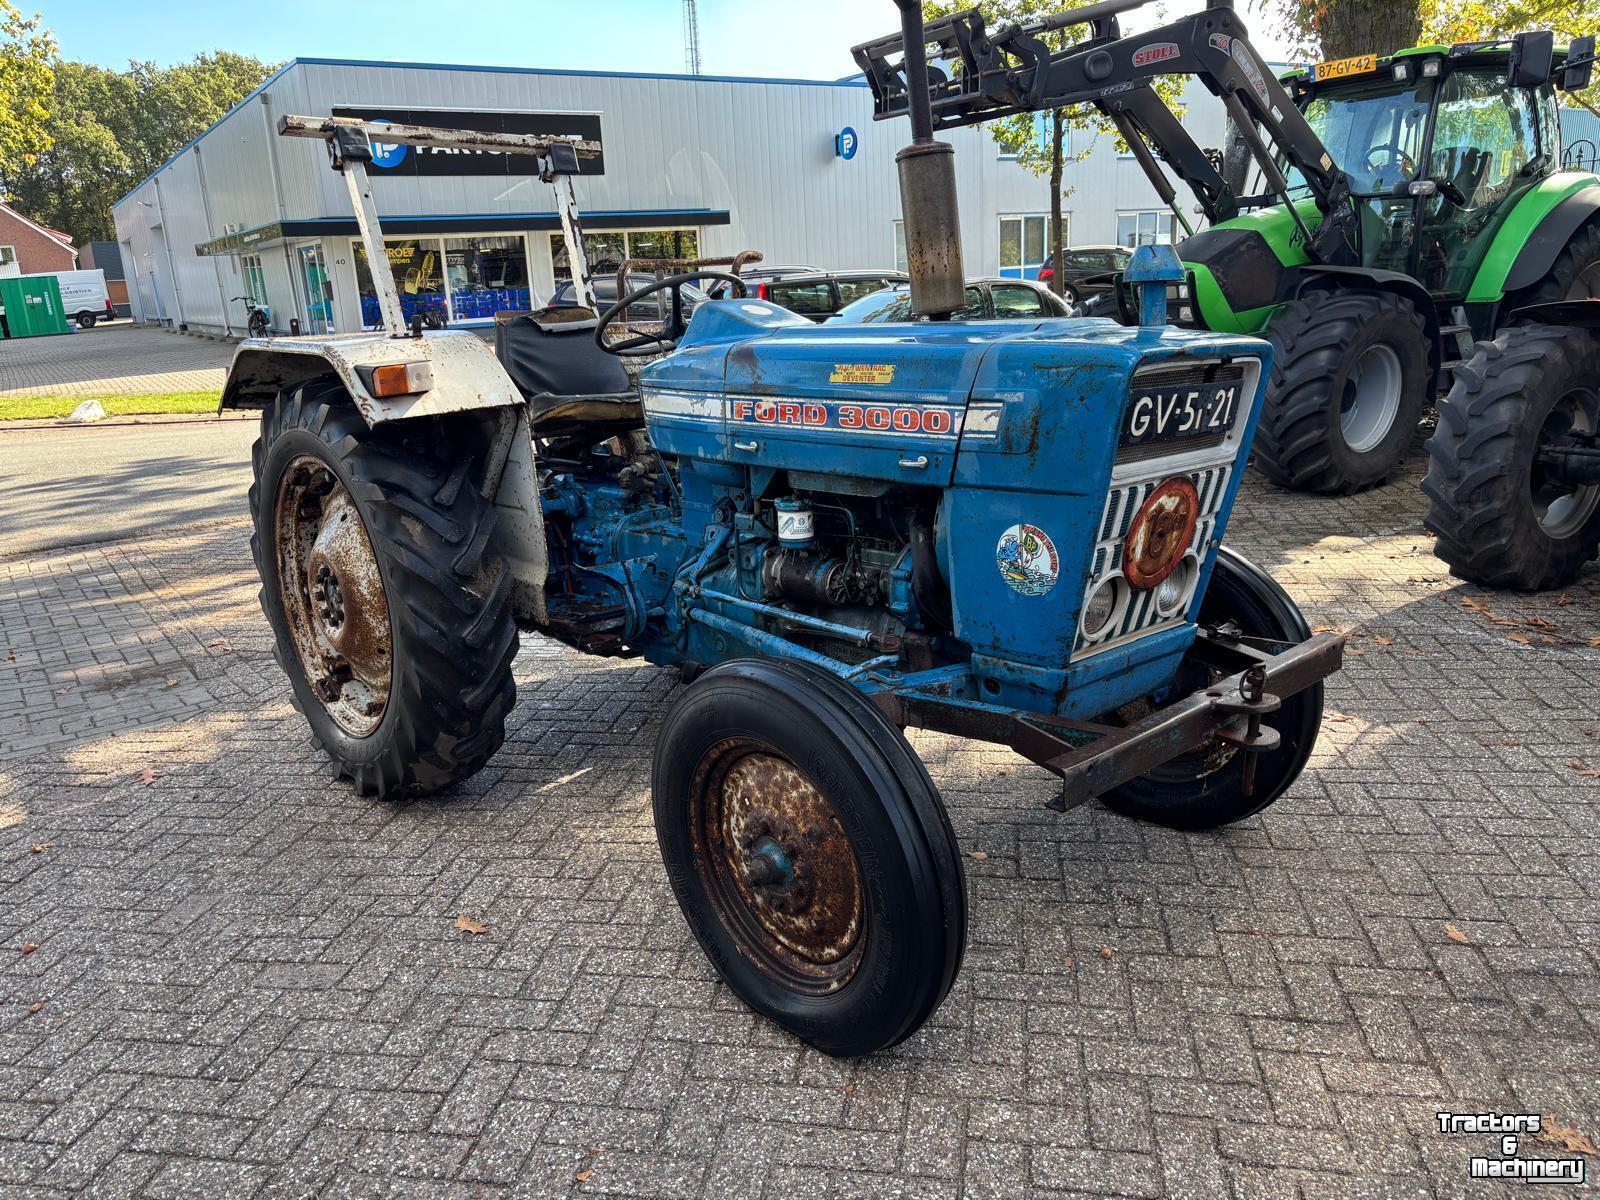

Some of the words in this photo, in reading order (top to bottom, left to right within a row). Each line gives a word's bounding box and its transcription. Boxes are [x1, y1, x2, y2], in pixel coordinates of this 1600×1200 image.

[1135, 45, 1177, 65] STOLL
[1318, 57, 1371, 78] 87-GV-42
[733, 400, 827, 425] FORD
[838, 406, 951, 434] 3000
